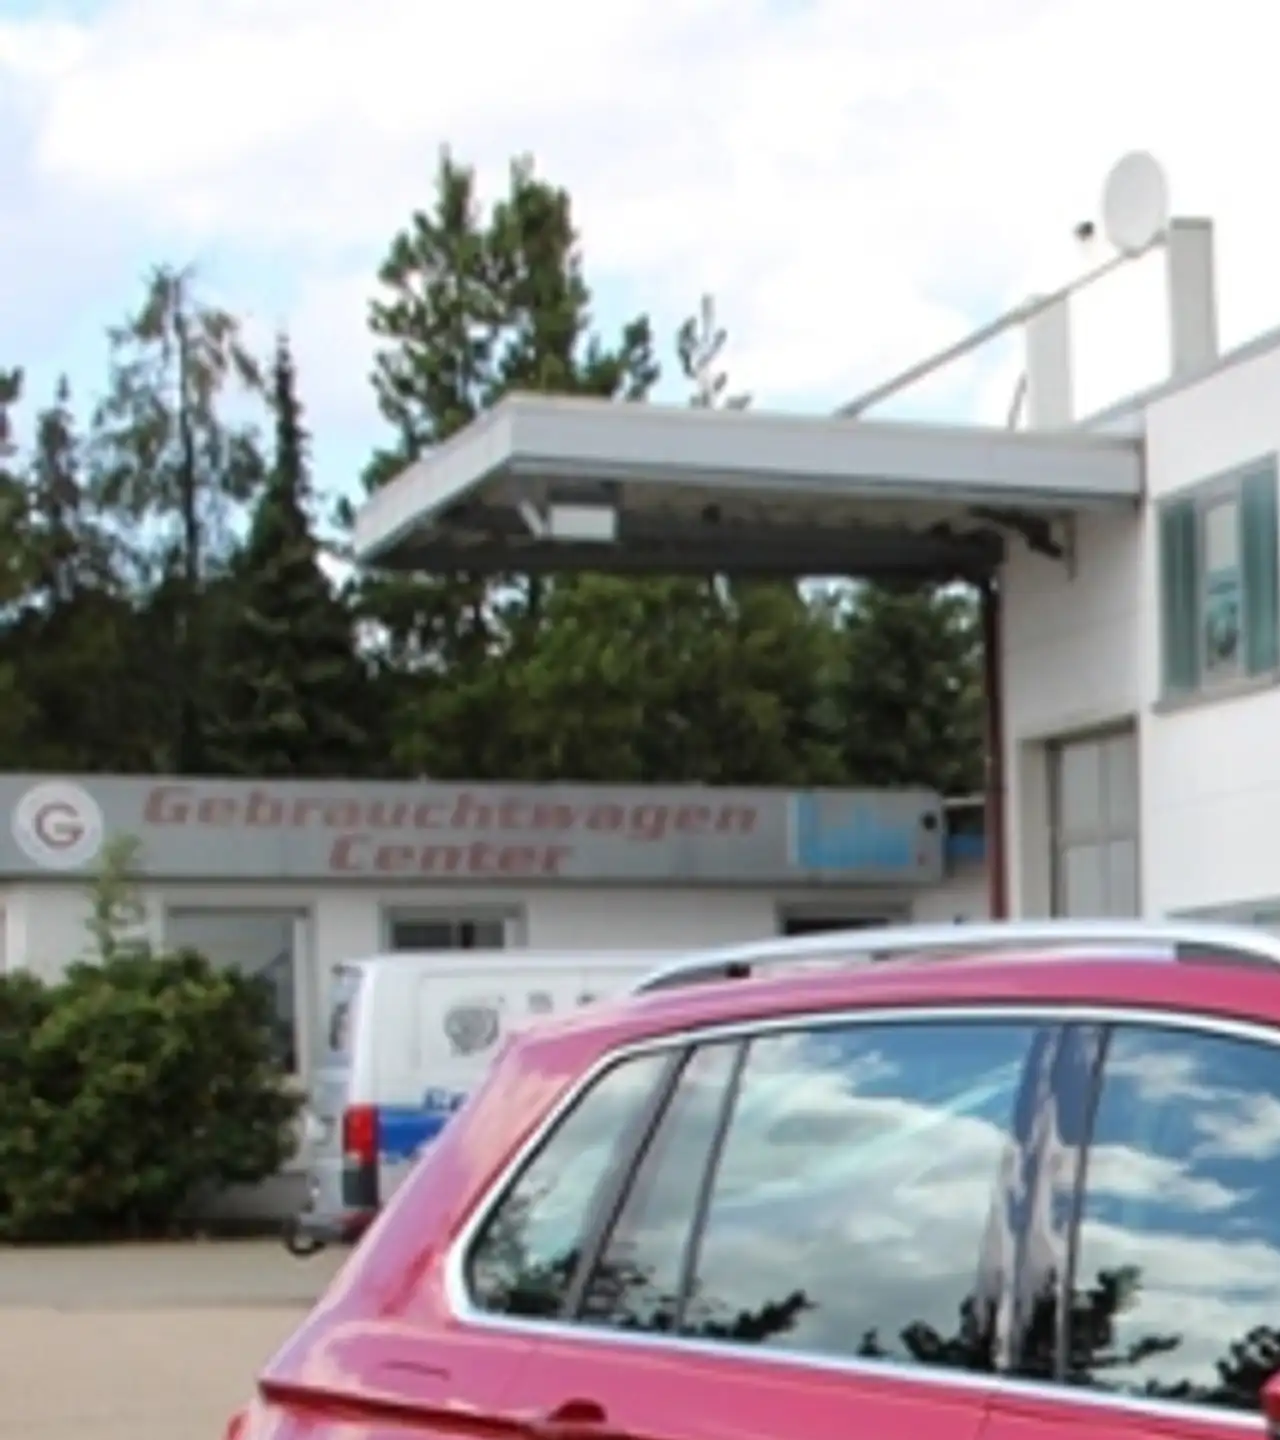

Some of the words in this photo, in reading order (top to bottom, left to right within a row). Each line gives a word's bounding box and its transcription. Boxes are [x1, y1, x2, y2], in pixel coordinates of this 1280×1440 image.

[34, 803, 84, 849] G
[142, 785, 760, 841] Gebrauchtwagen
[326, 832, 576, 874] Center
